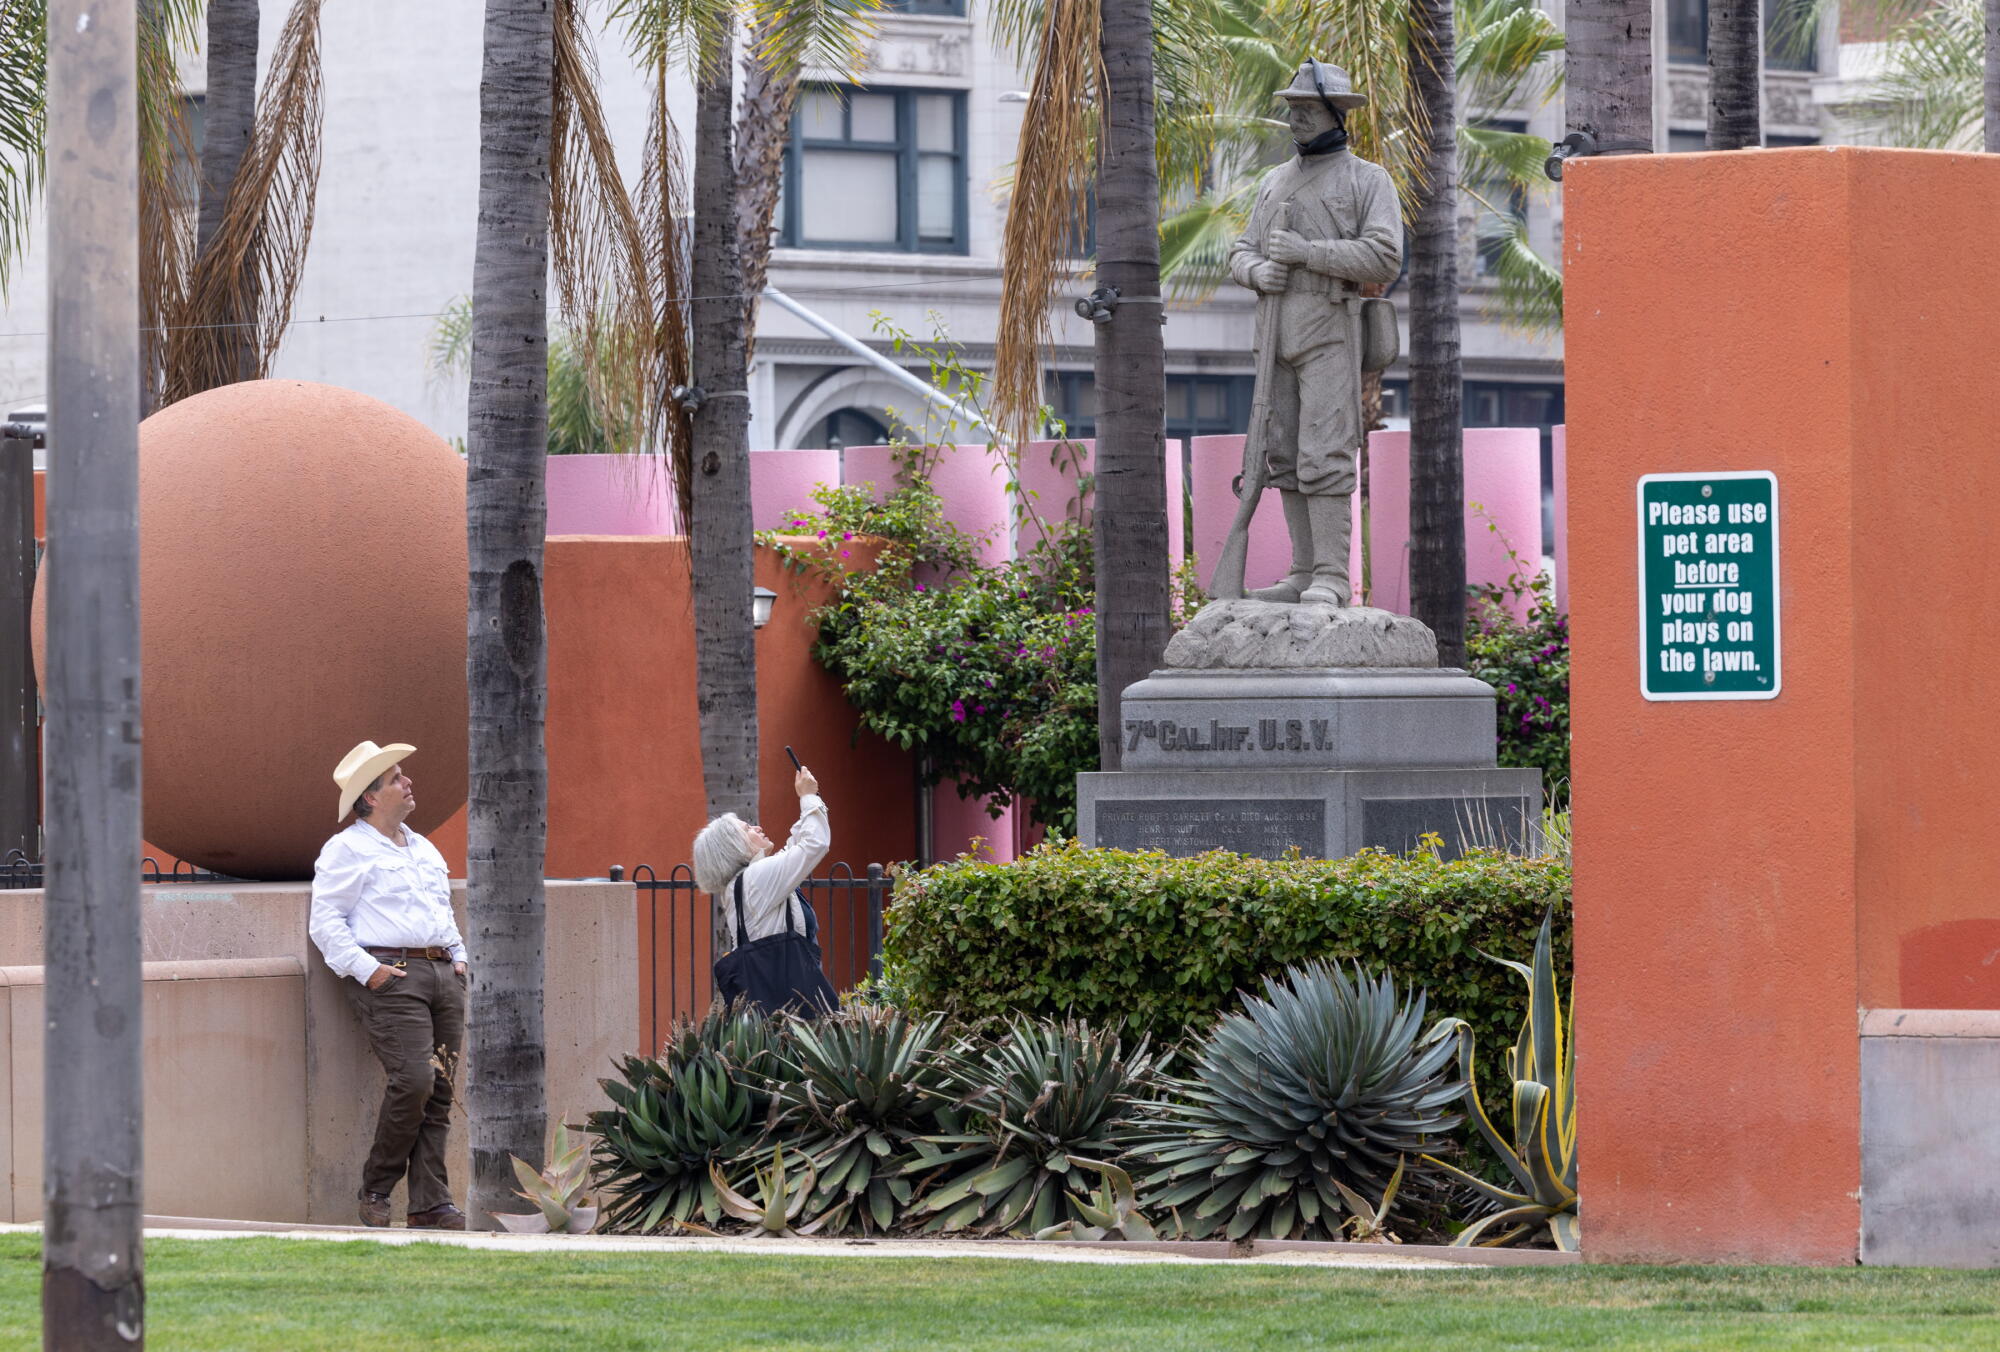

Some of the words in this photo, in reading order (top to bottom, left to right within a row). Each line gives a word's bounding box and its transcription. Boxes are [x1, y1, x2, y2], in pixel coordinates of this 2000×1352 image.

[1649, 502, 1720, 526] Please
[1728, 503, 1767, 524] use
[1663, 532, 1698, 557] pet
[1705, 532, 1753, 554] area
[1674, 560, 1739, 584] before
[1661, 593, 1706, 616] your
[1713, 589, 1752, 615] dog
[1662, 619, 1719, 645] plays
[1727, 621, 1754, 642] on
[1660, 648, 1696, 672] the
[1703, 648, 1760, 672] lawn.
[1258, 719, 1333, 751] U.S.V.
[1102, 812, 1135, 822] PRIVATE
[1241, 812, 1260, 821] DIED
[1138, 824, 1165, 834] HENRY
[1263, 824, 1279, 834] MAY
[1262, 837, 1280, 846] JULY
